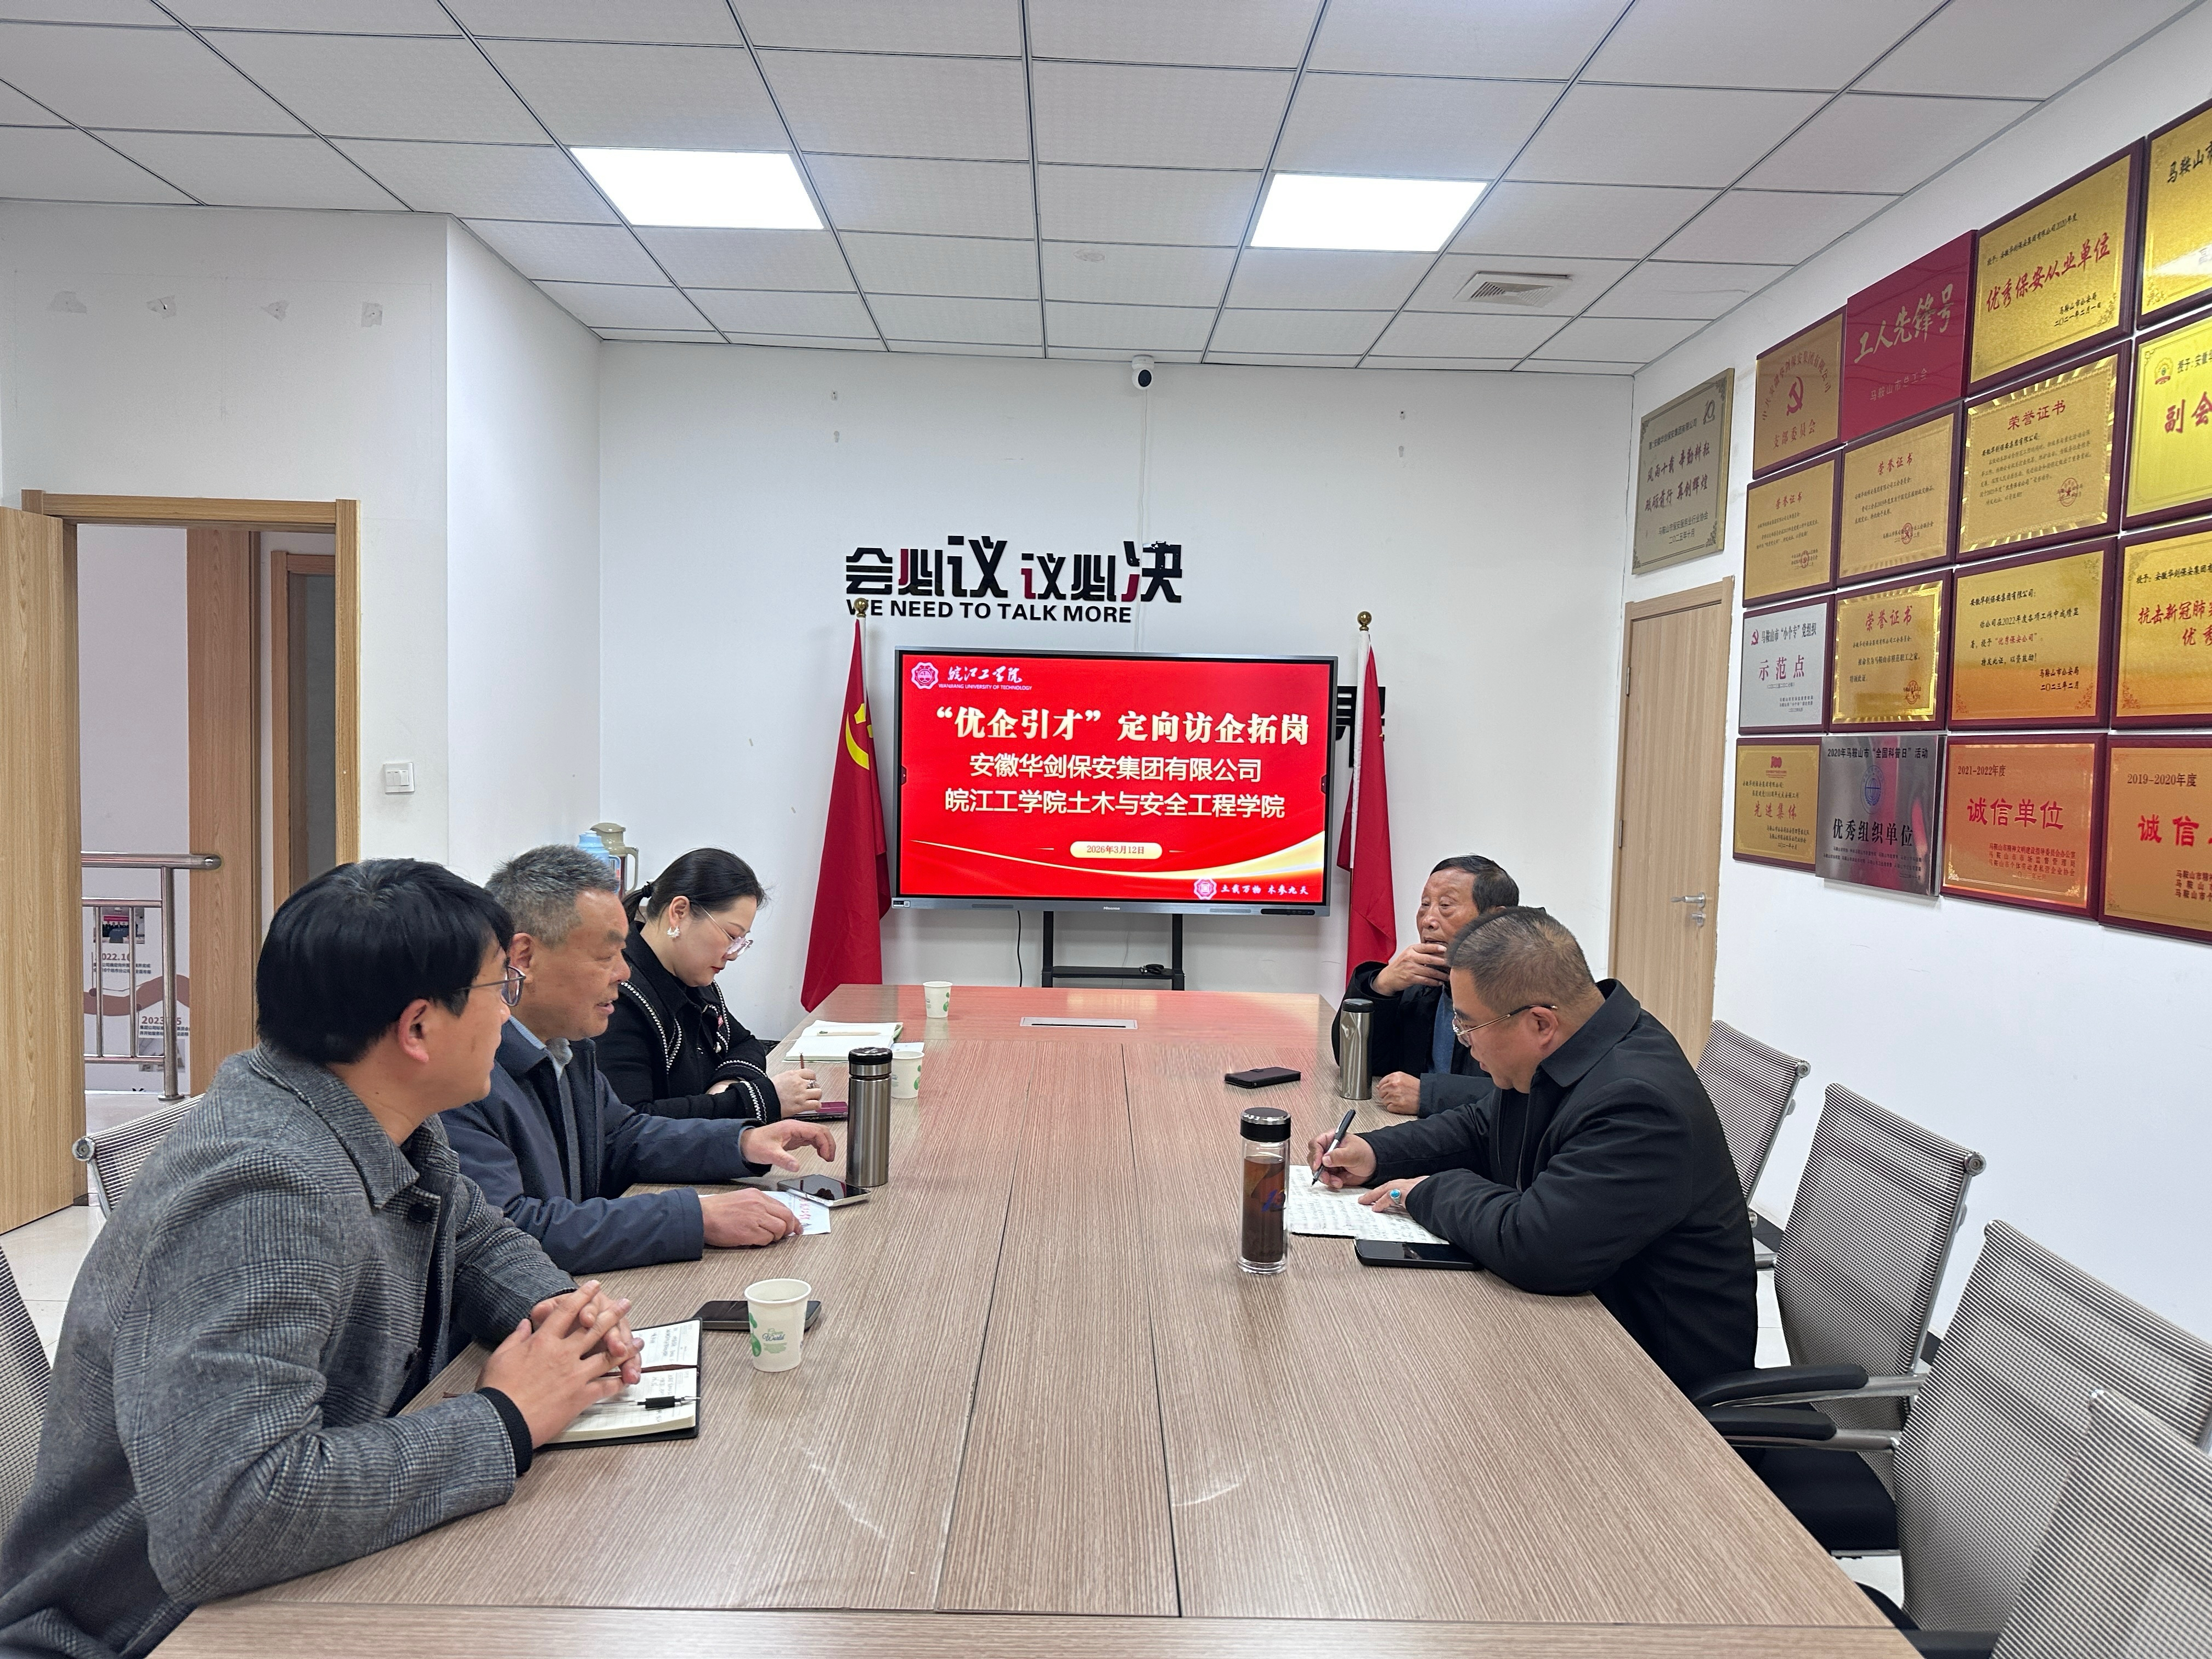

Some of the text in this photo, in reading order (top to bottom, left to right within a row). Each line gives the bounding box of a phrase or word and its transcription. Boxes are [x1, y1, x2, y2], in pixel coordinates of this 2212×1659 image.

[1987, 232, 2110, 313] 优秀保安从业单位
[1854, 283, 1953, 364] 工人先锋号
[1870, 368, 1927, 401] 马鞍山市总工会
[2007, 399, 2066, 431] 荣誉证书
[1773, 419, 1816, 449] 支部委员会
[1647, 441, 1710, 483] 风雨十载 辛勤耕耘
[1877, 452, 1913, 475] 荣誉证书
[1645, 473, 1708, 512] 砥砺前行 再创辉煌
[1775, 492, 1803, 509] 荣誉证书
[846, 535, 1182, 603] 会必议 议必决
[890, 600, 953, 618] NEED
[960, 602, 991, 619] TO
[997, 603, 1058, 621] TALK
[1063, 605, 1131, 623] MORE
[1865, 605, 1912, 631] 荣誉证书
[947, 665, 1023, 684] 皖江工学院
[1758, 654, 1804, 681] 示范点
[2039, 666, 2079, 678] 马鞍山市公安局
[1827, 747, 1928, 759] 2020年马鞍山市“全国科普日”活动
[969, 752, 1262, 782] 安徽华剑保安集团有限公司
[1957, 764, 2006, 777] 2021-2022年度
[2127, 773, 2197, 786] 2019-2020年度
[945, 788, 1285, 819] 皖江工学院土木与安全工程学院
[1754, 800, 1797, 820] 先进集体
[1967, 797, 2064, 830] 诚信单位
[1832, 817, 1913, 847] 优秀组织单位
[2138, 814, 2212, 847] 诚信
[1086, 845, 1144, 854] 2026年3月12日
[1989, 843, 2076, 859] 马鞍山市精神文明建设指导委员会办公室
[1989, 851, 2075, 868] 马鞍山市市场监督管理局
[1221, 884, 1261, 894] 土载万物
